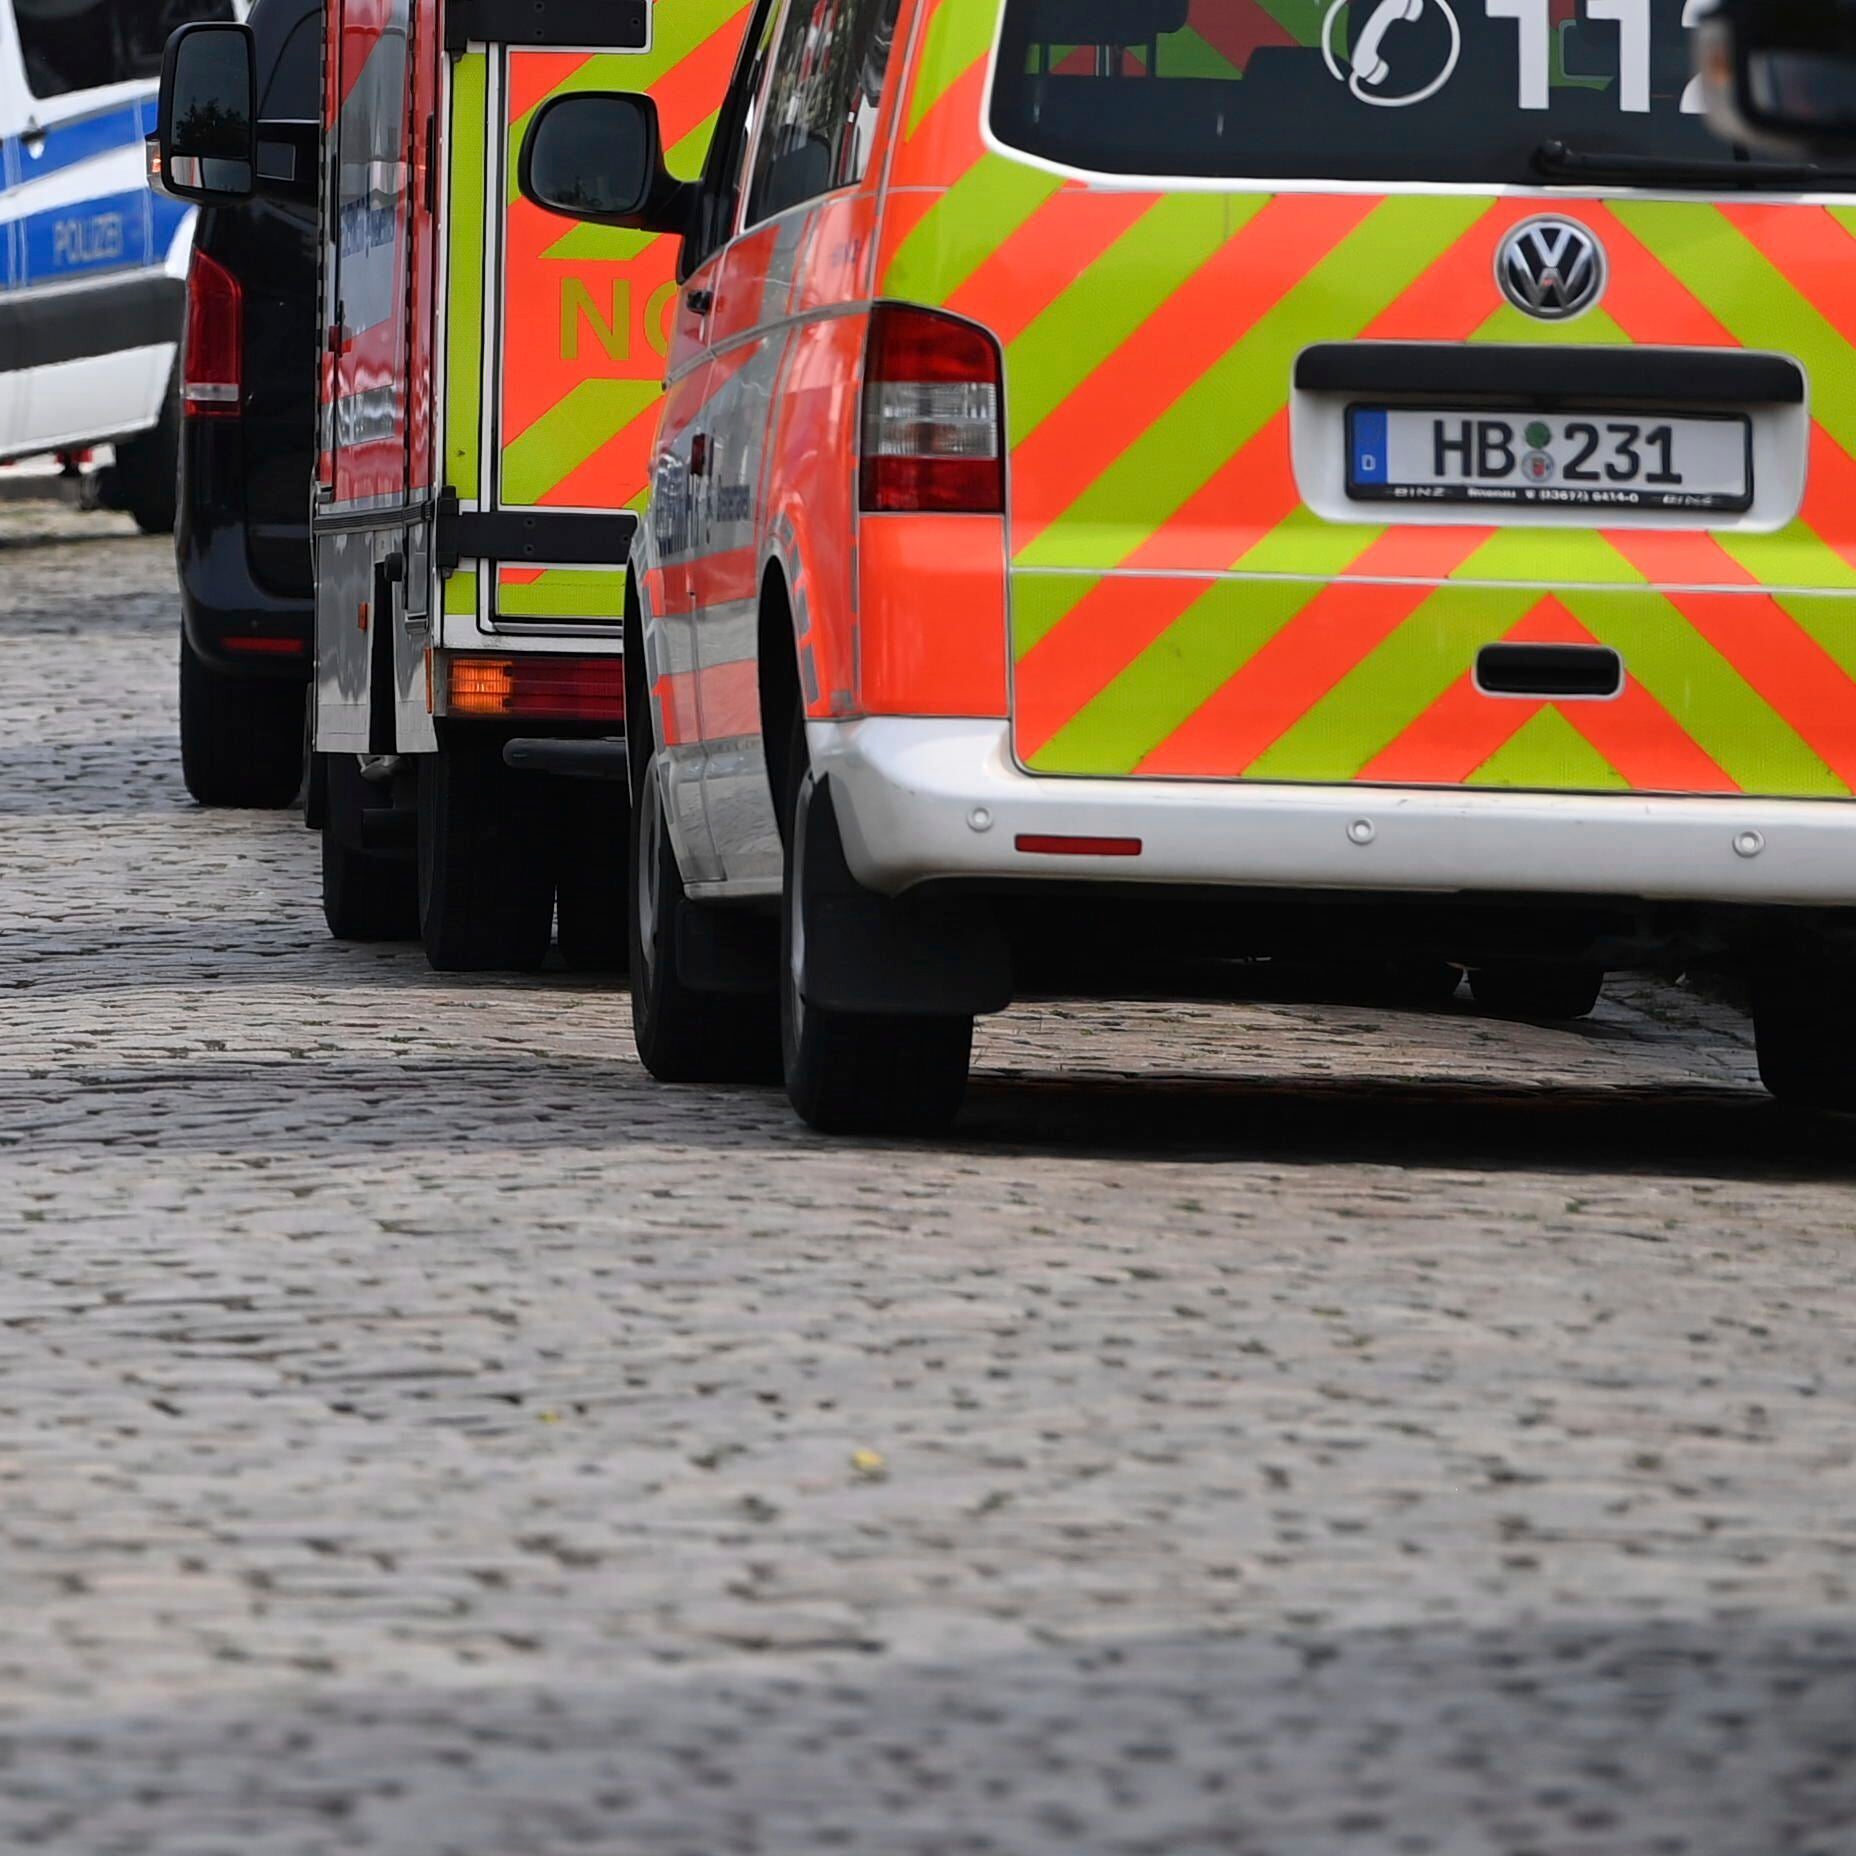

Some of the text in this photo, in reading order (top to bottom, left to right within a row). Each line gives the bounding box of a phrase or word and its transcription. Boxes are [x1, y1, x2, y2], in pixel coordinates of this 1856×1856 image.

[1361, 454, 1376, 471] D
[1433, 419, 1682, 485] HB 231
